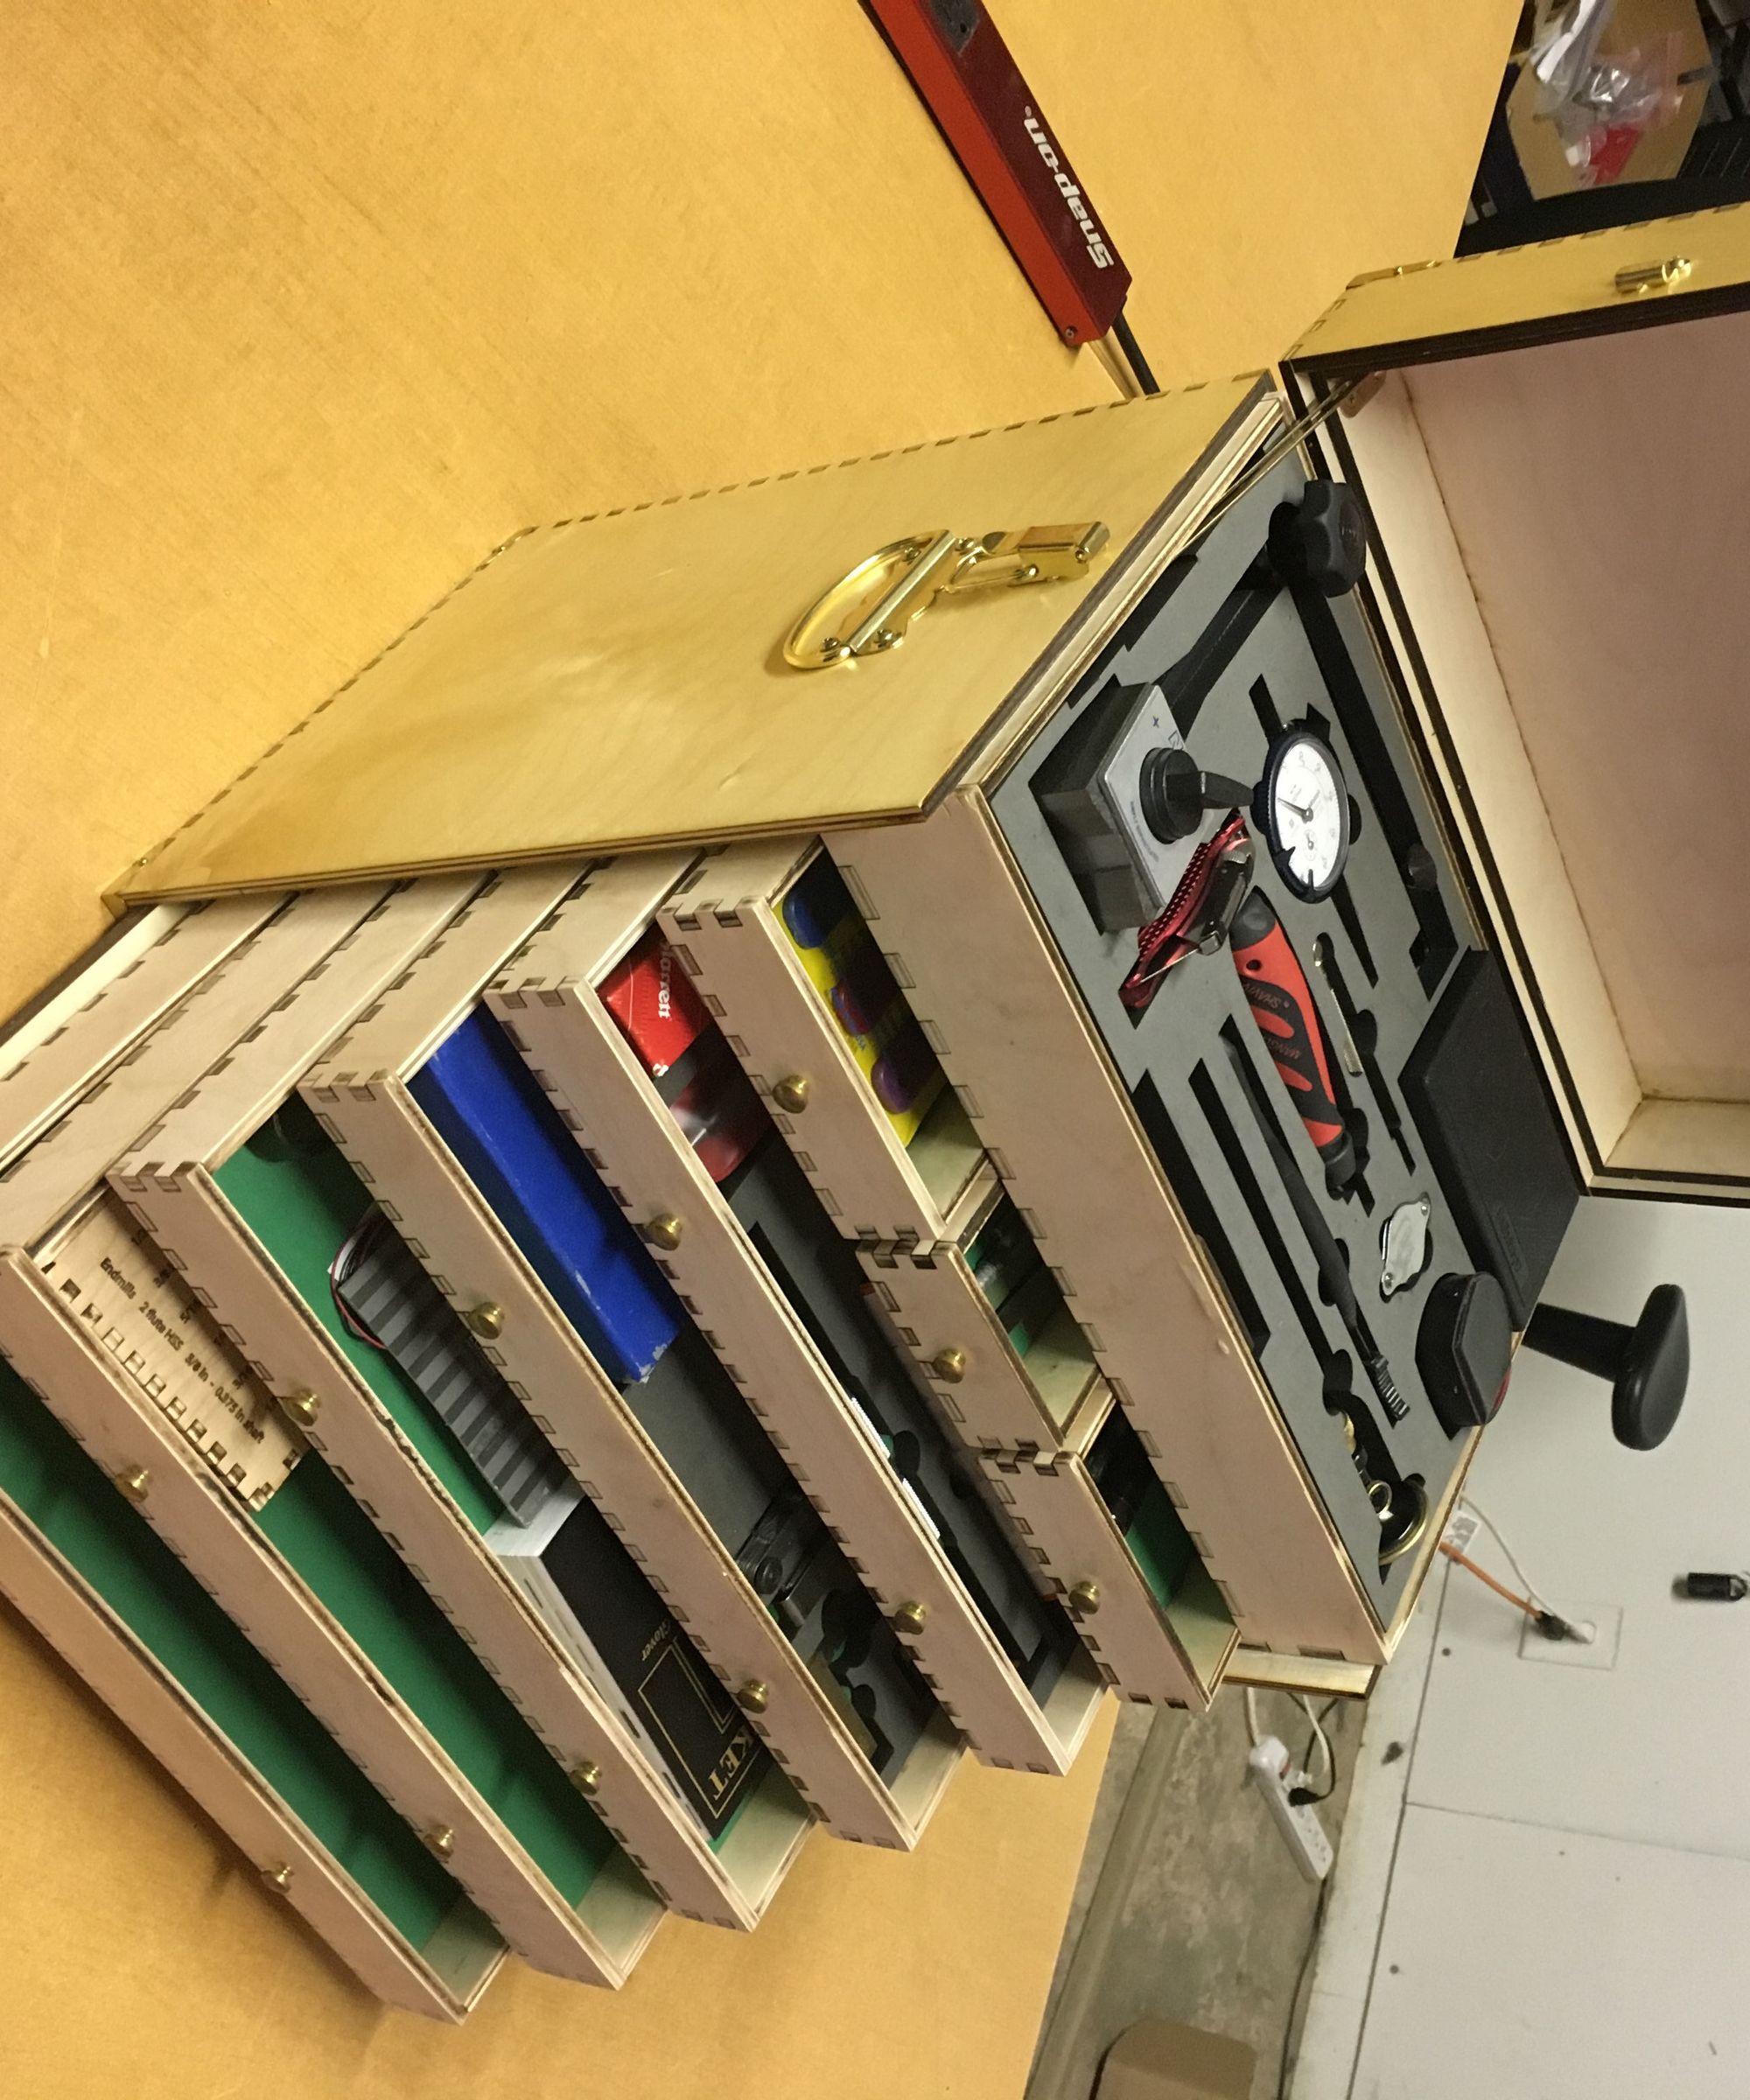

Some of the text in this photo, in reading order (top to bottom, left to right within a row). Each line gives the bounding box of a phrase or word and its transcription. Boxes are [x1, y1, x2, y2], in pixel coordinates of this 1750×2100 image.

[101, 1257, 136, 1299] Endmills
[138, 1301, 150, 1313] 2
[145, 1308, 166, 1334] flute
[164, 1328, 184, 1351] HSS
[198, 1367, 209, 1382] in
[234, 1408, 245, 1424] in
[243, 1419, 265, 1444] shaft
